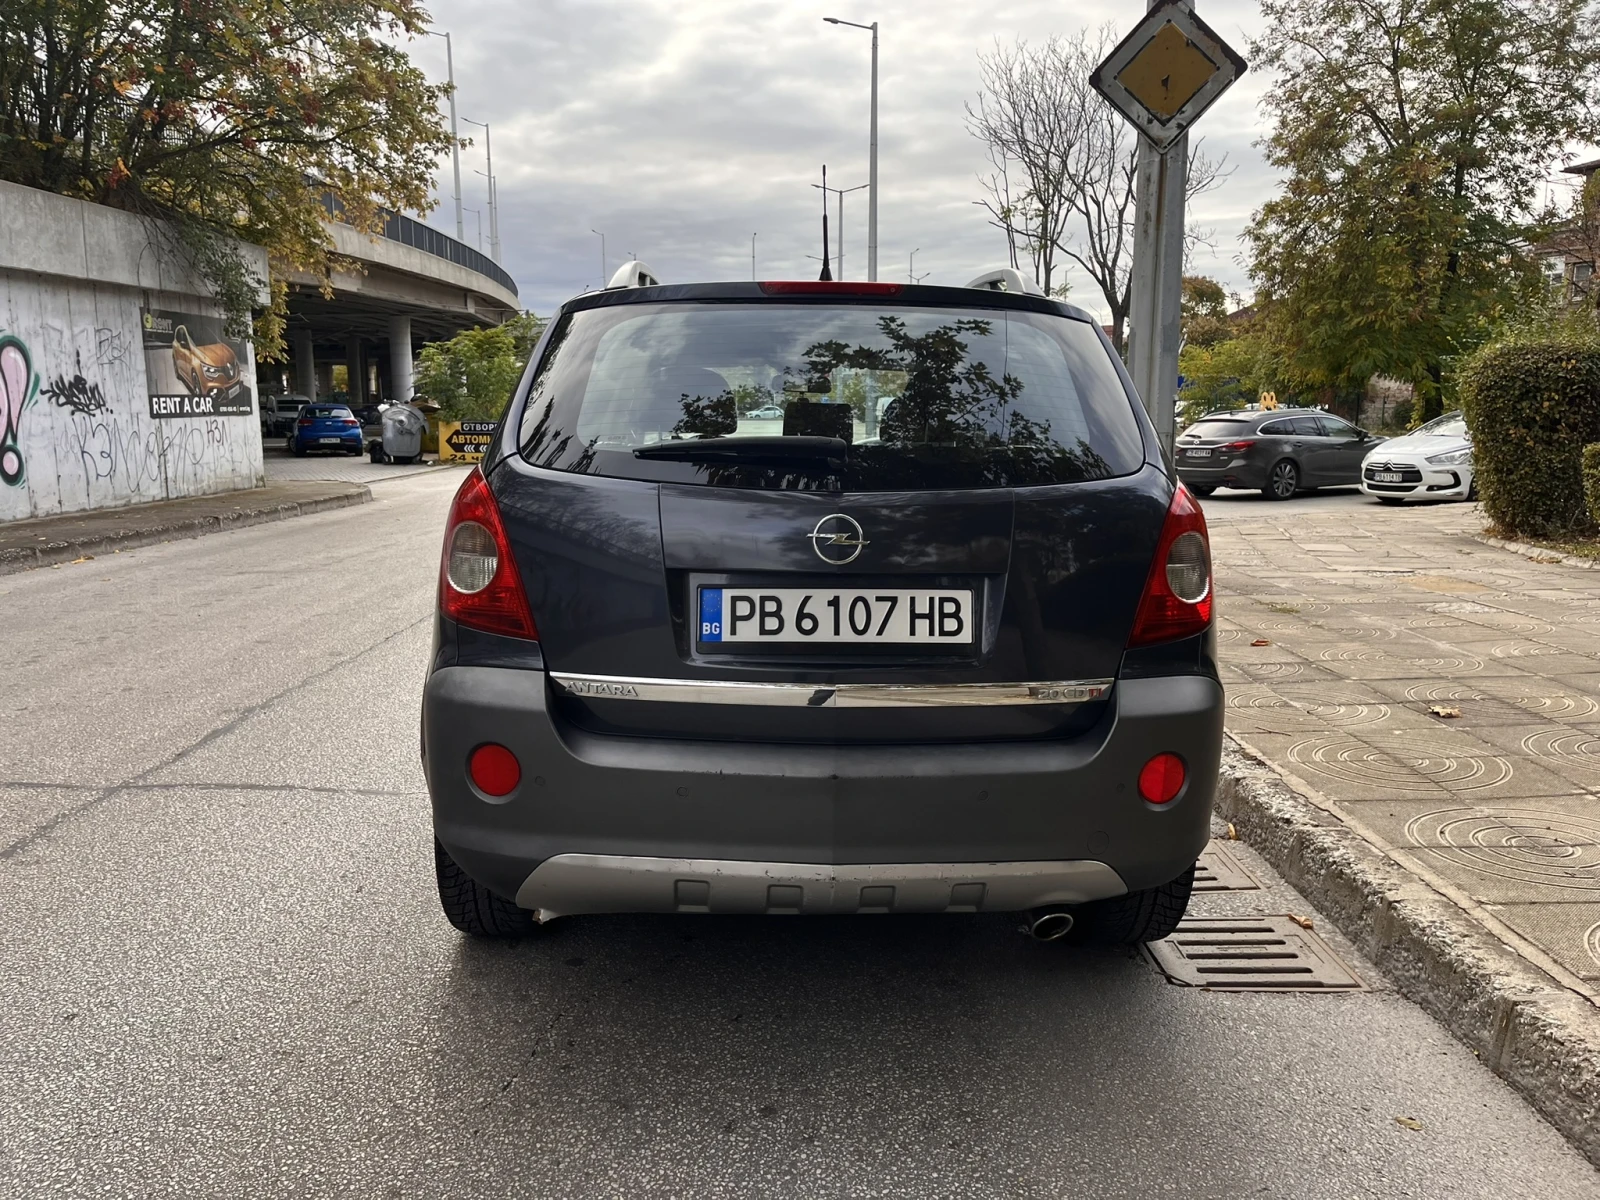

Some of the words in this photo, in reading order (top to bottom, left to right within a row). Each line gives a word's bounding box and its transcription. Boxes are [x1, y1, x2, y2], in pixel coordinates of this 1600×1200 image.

[152, 397, 181, 414] RENT
[184, 397, 191, 413] A
[193, 397, 214, 413] CAR
[463, 423, 497, 431] ОТВОР
[729, 595, 785, 636] PB
[795, 595, 898, 637] 6107
[909, 596, 964, 637] HB
[702, 622, 720, 635] BG
[565, 681, 639, 697] ANTARA
